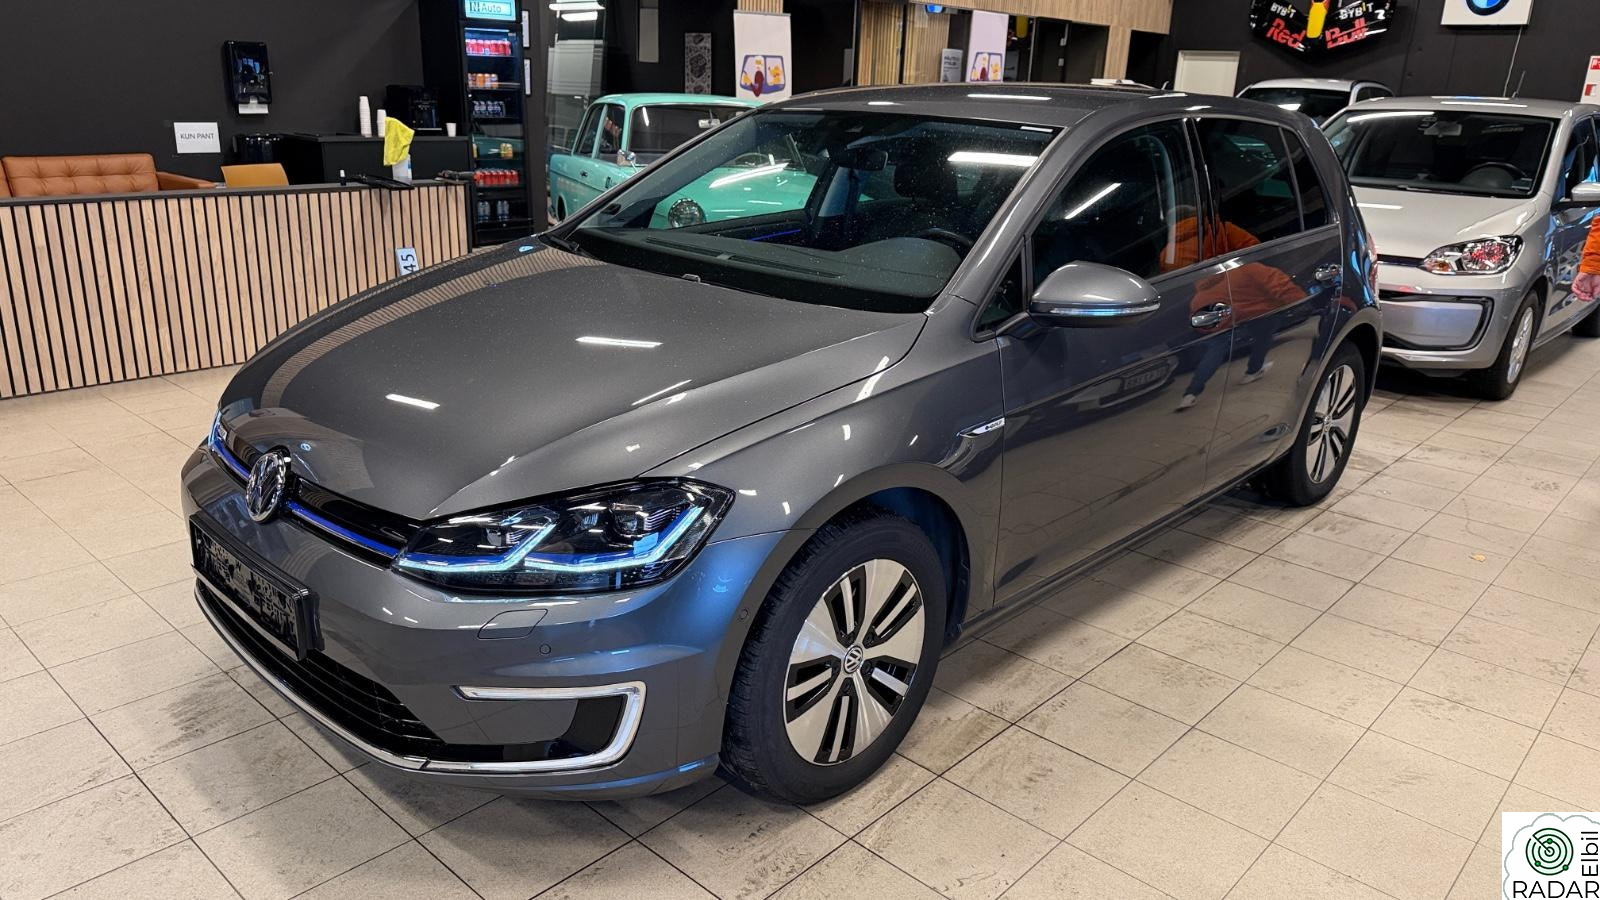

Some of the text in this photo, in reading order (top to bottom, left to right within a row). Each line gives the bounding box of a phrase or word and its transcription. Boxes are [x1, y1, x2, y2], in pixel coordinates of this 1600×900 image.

[482, 3, 502, 13] Auto
[1270, 2, 1296, 18] BYBIT
[1339, 3, 1374, 20] BYBIT
[1265, 18, 1306, 49] Red
[1325, 17, 1369, 48] Bull
